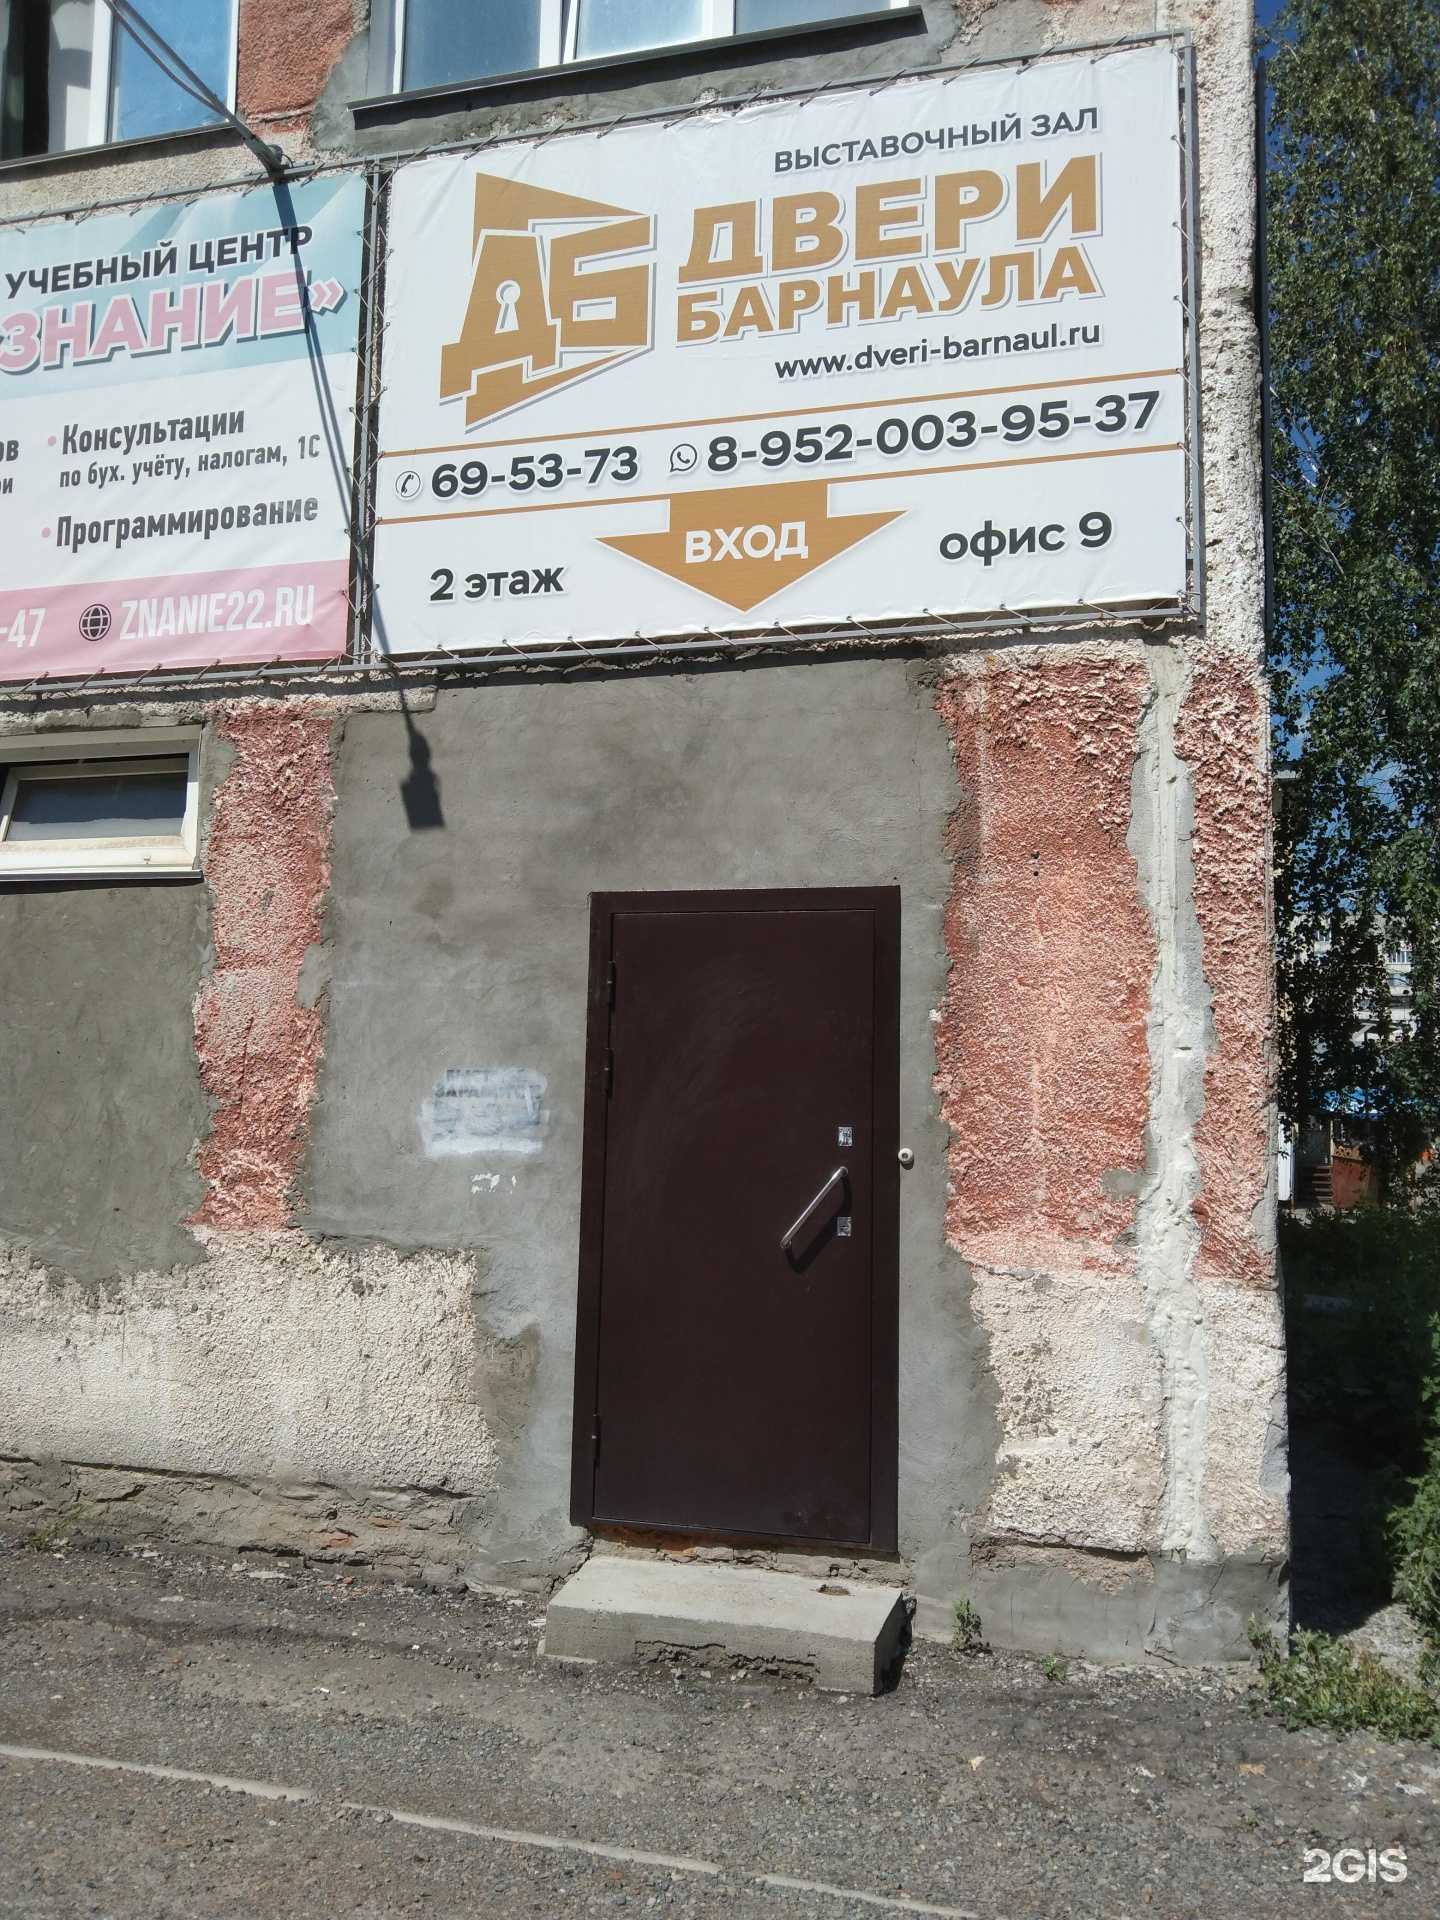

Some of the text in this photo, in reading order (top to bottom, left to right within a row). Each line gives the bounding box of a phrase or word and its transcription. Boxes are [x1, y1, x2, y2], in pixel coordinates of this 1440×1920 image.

[775, 107, 1098, 172] ВЫСТАВОЧНЫЙ ЗАЛ
[678, 154, 1102, 284] ДВЕРИ
[5, 225, 313, 299] УЧЕБНЫЙ ЦЕНТР
[676, 246, 1103, 344] БАРНАУЛА
[775, 322, 1100, 380] www.dveri-barnaul.ru
[62, 410, 245, 455] Консультации
[431, 391, 1160, 498] 69-53-73 8-952-003-95-37
[59, 434, 321, 490] по бух. учёту, налогам, 1С
[56, 496, 319, 553] Программирование
[685, 521, 809, 564] ВХОД
[939, 511, 1114, 566] офис 9
[430, 566, 566, 601] 2 этаж
[119, 584, 316, 642] ZNANIE22.RU
